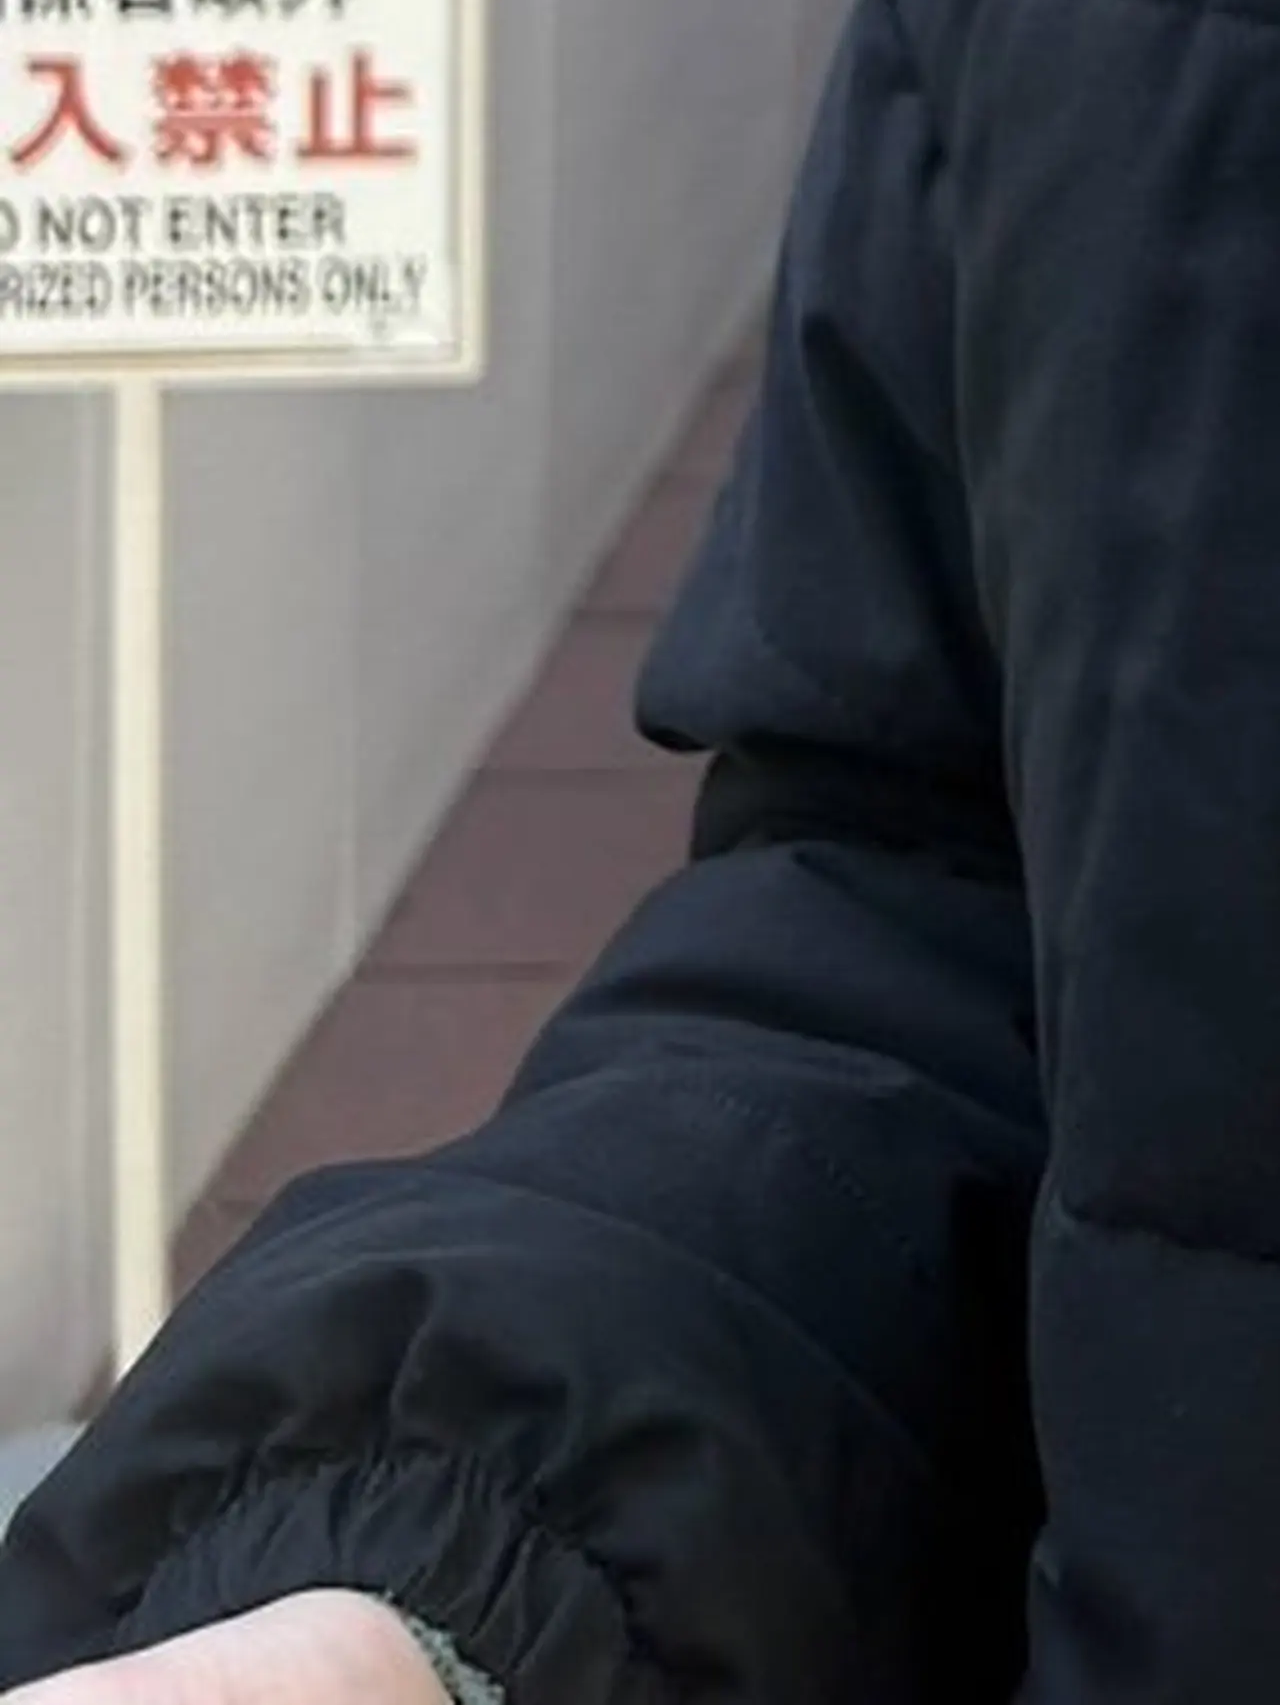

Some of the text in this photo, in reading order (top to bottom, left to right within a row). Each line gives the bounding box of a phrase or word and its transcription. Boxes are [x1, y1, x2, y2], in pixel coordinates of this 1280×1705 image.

[8, 46, 416, 165] 入禁止
[36, 195, 149, 252] NOT
[163, 192, 347, 249] ENTER
[119, 257, 311, 318] PERSONS
[316, 253, 428, 315] ONLY
